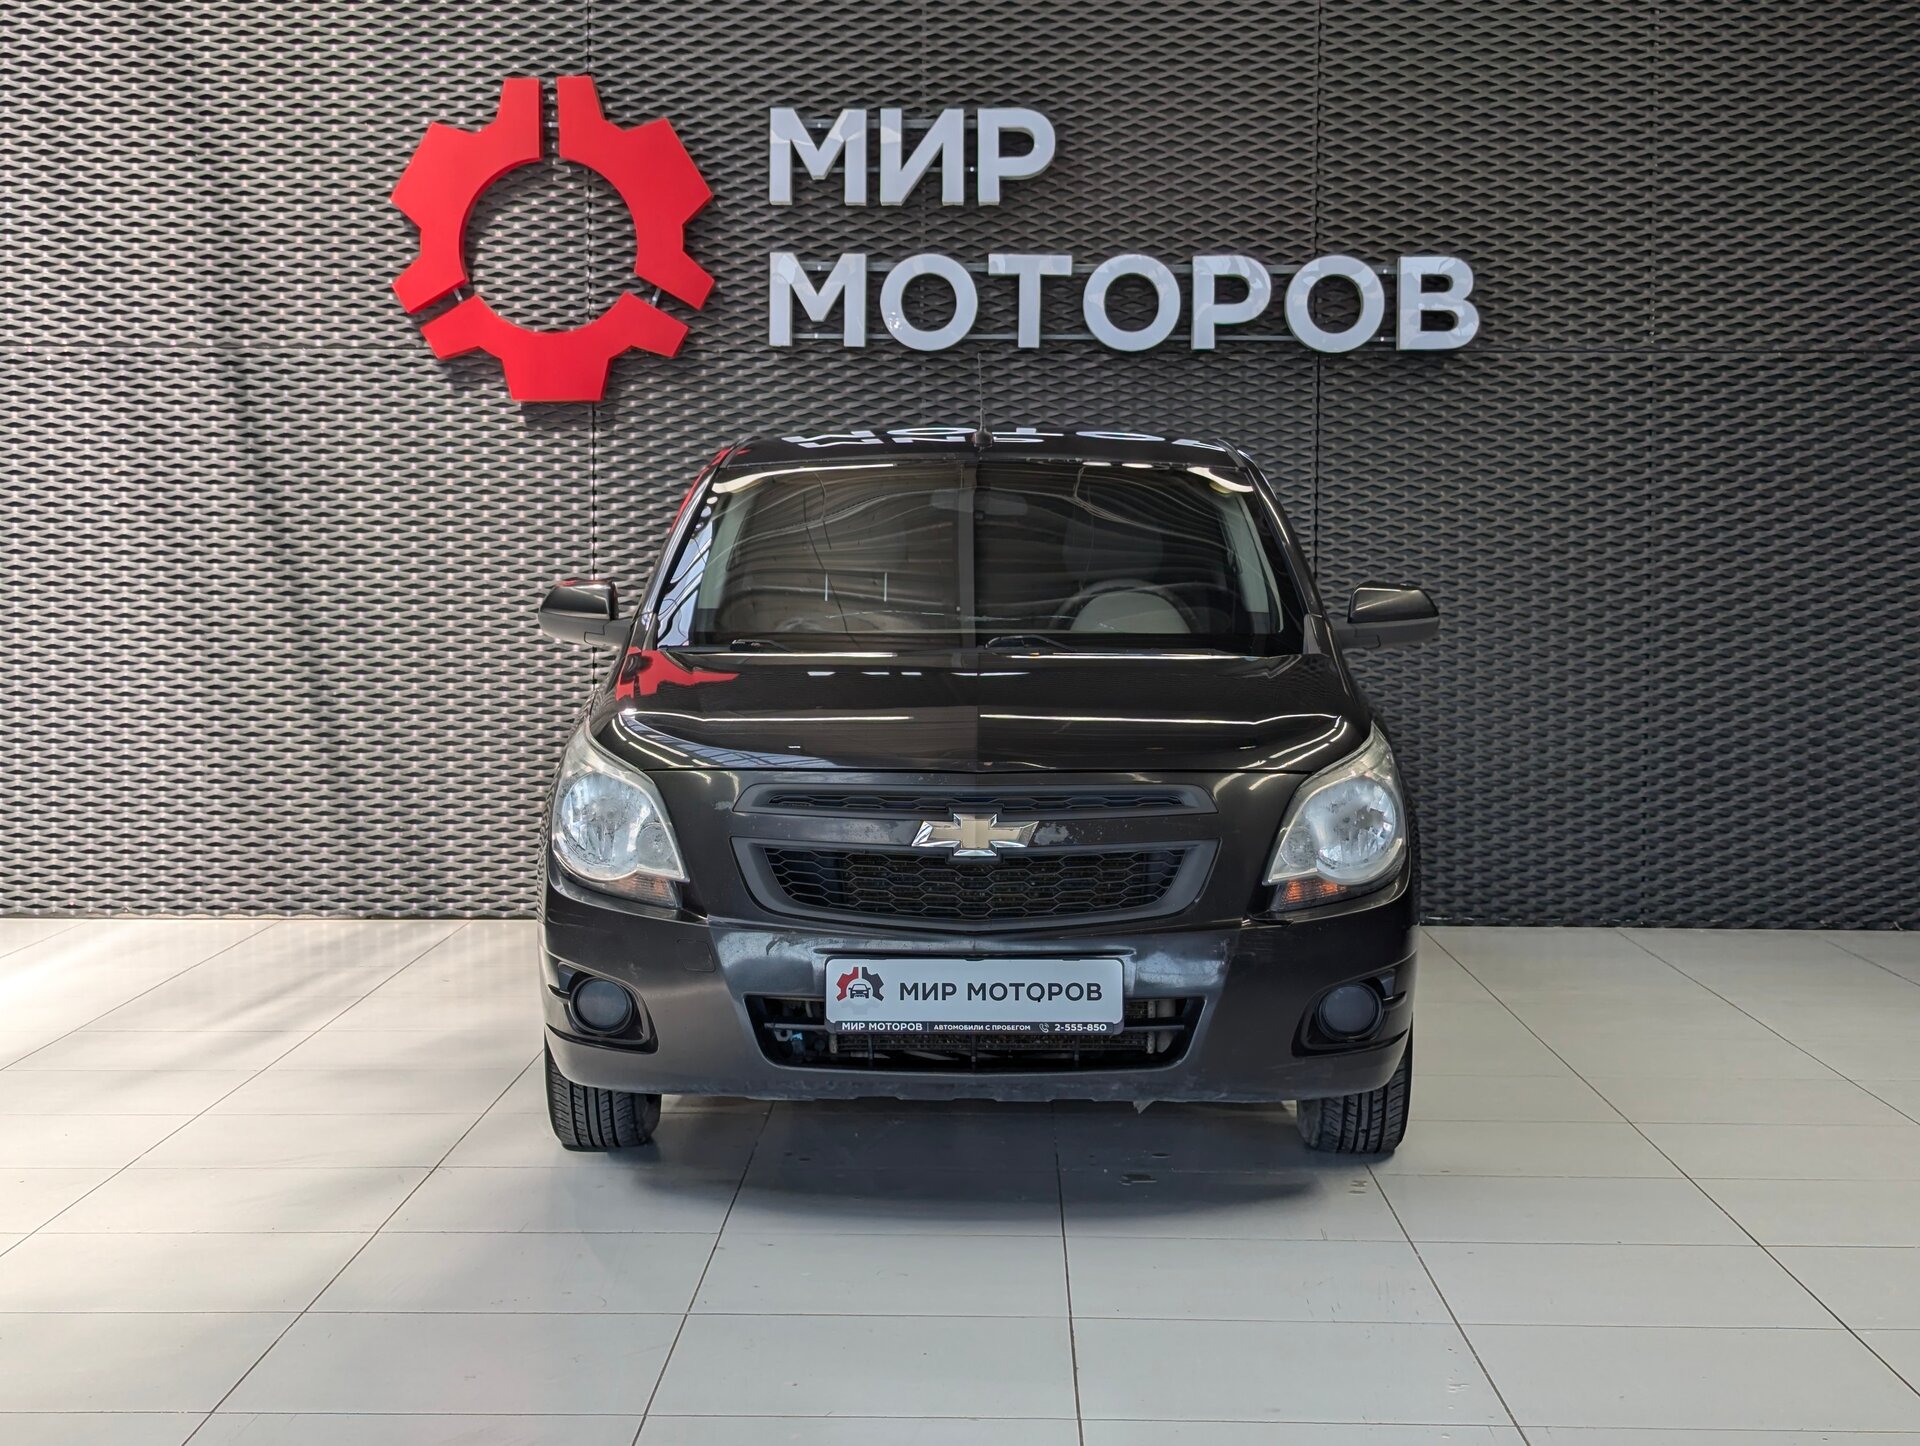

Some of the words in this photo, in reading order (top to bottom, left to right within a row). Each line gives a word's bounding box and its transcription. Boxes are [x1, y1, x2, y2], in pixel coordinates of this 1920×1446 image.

[769, 107, 1056, 205] МИР
[769, 252, 1481, 353] МОТОРОВ
[900, 982, 957, 1001] МИР
[967, 982, 1103, 1002] МОТОРОВ
[841, 1022, 866, 1031] МИР
[868, 1022, 923, 1031] МОТОРОВ
[1054, 1023, 1107, 1032] 2-555-850
